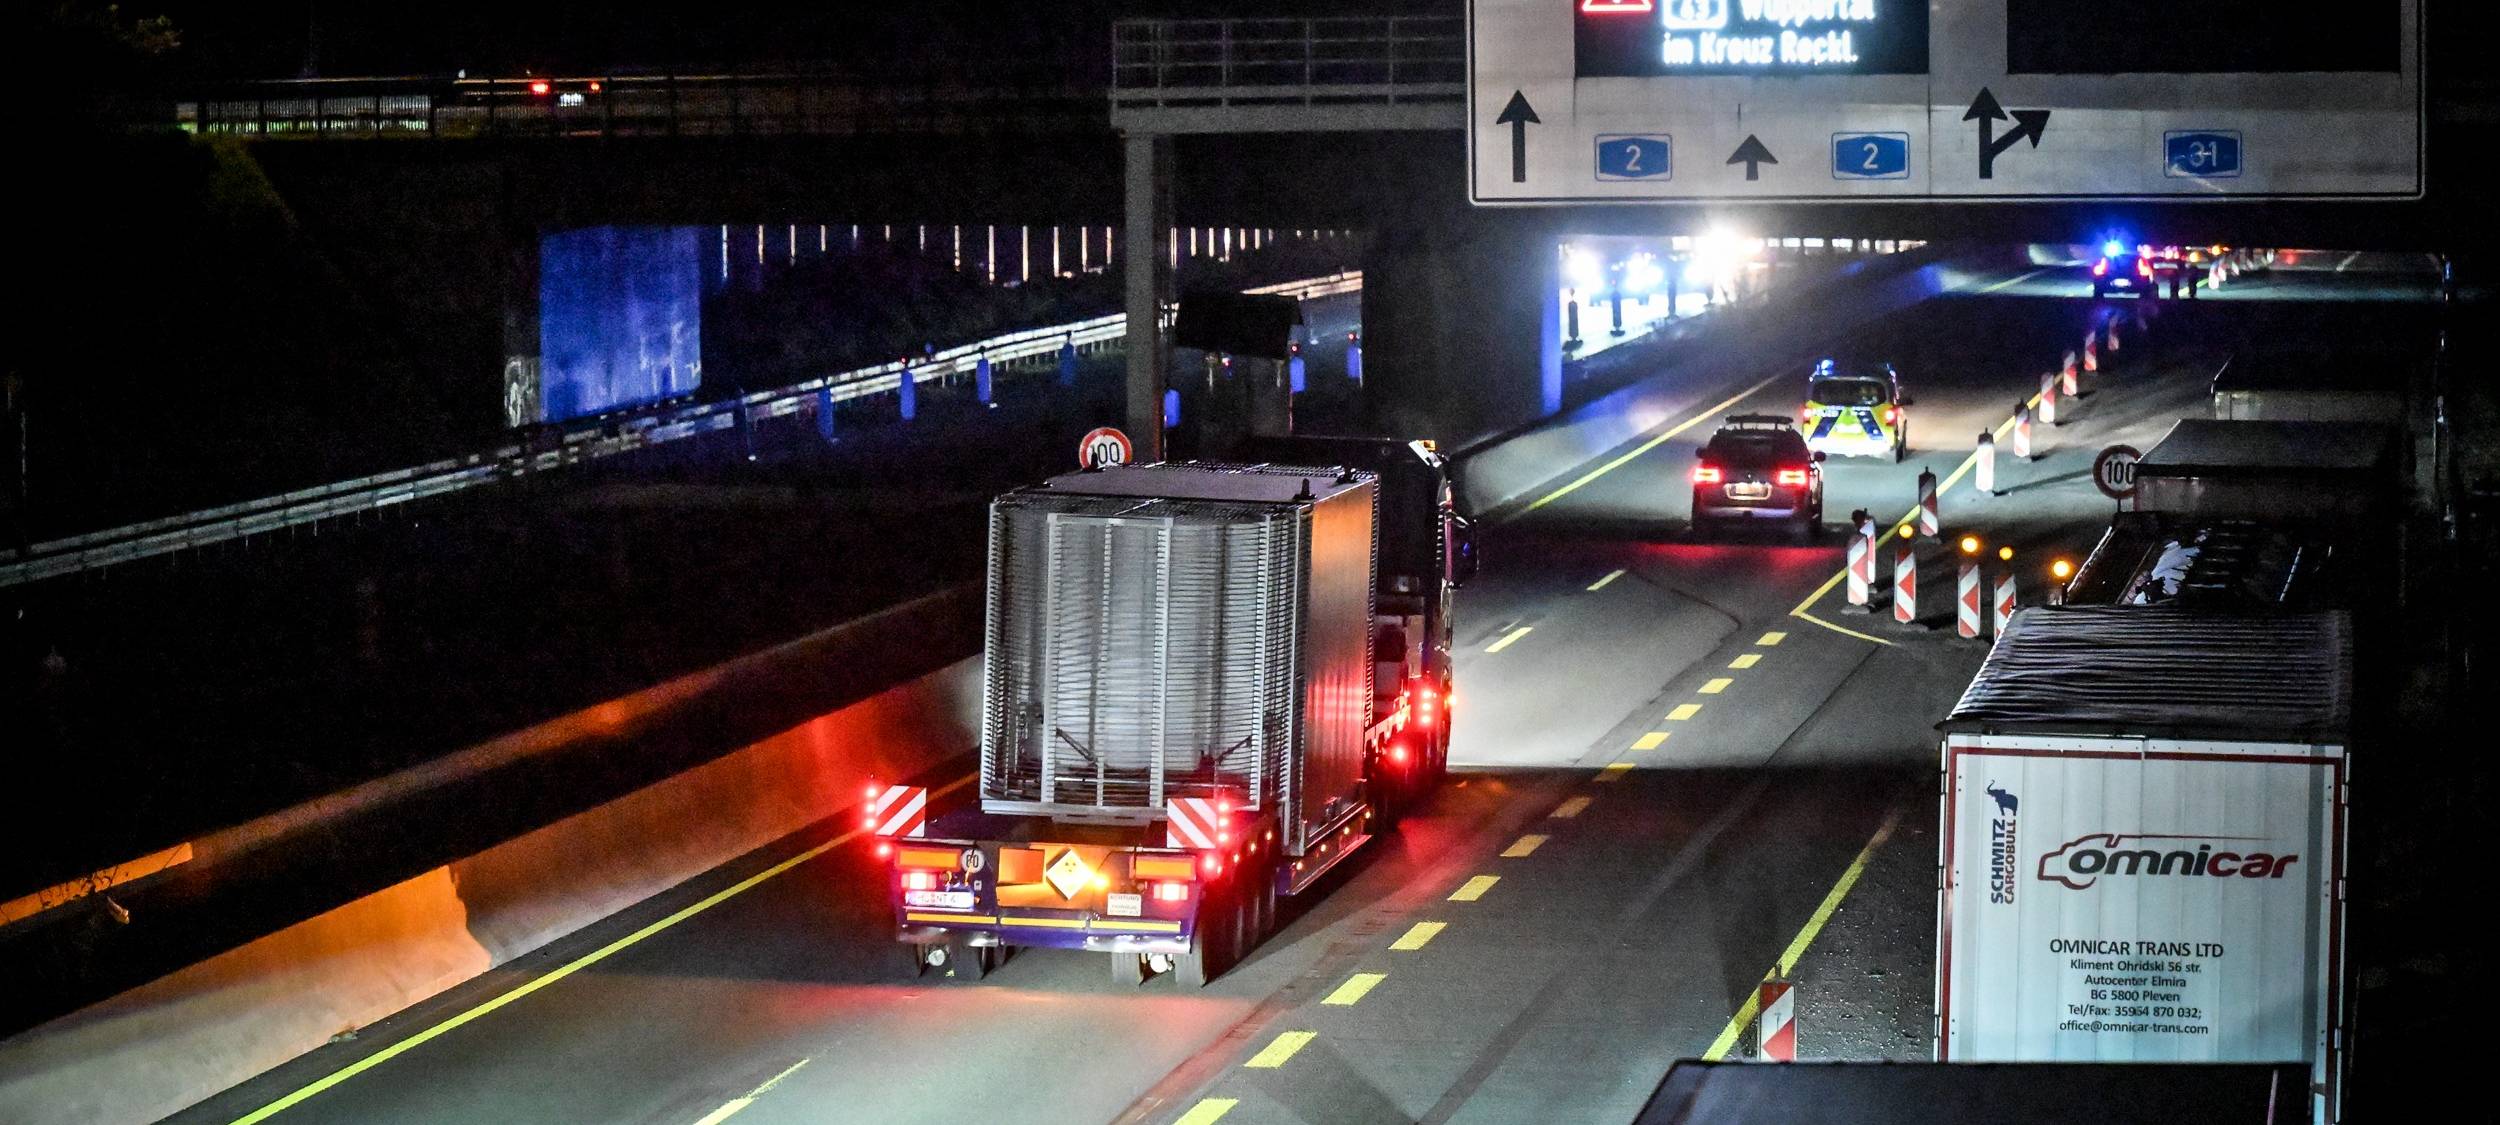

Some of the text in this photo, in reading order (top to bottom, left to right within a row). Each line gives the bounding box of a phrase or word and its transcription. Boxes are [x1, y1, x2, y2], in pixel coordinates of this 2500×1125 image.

[1663, 32, 1694, 64] im
[1700, 31, 1773, 64] Kreuz
[1626, 145, 1642, 171] 2
[1863, 143, 1879, 169] 2
[2189, 141, 2217, 168] 31
[1091, 441, 1120, 465] 00
[1991, 818, 2005, 904] SCHMITZ
[2004, 819, 2017, 905] CARGOBULL
[2068, 844, 2299, 879] omnicar
[2050, 938, 2224, 958] OMNICAR TRANS LTD
[2070, 959, 2202, 974] Kliment Ohridski 56 str.
[2084, 974, 2187, 988] Autocenter Elmira
[2090, 989, 2181, 1003] BG 5800 Pleven
[2067, 1003, 2111, 1017] Tel/Fax:
[2153, 1006, 2174, 1018] 870
[2059, 1018, 2209, 1035] office@omnicar-trans.com
